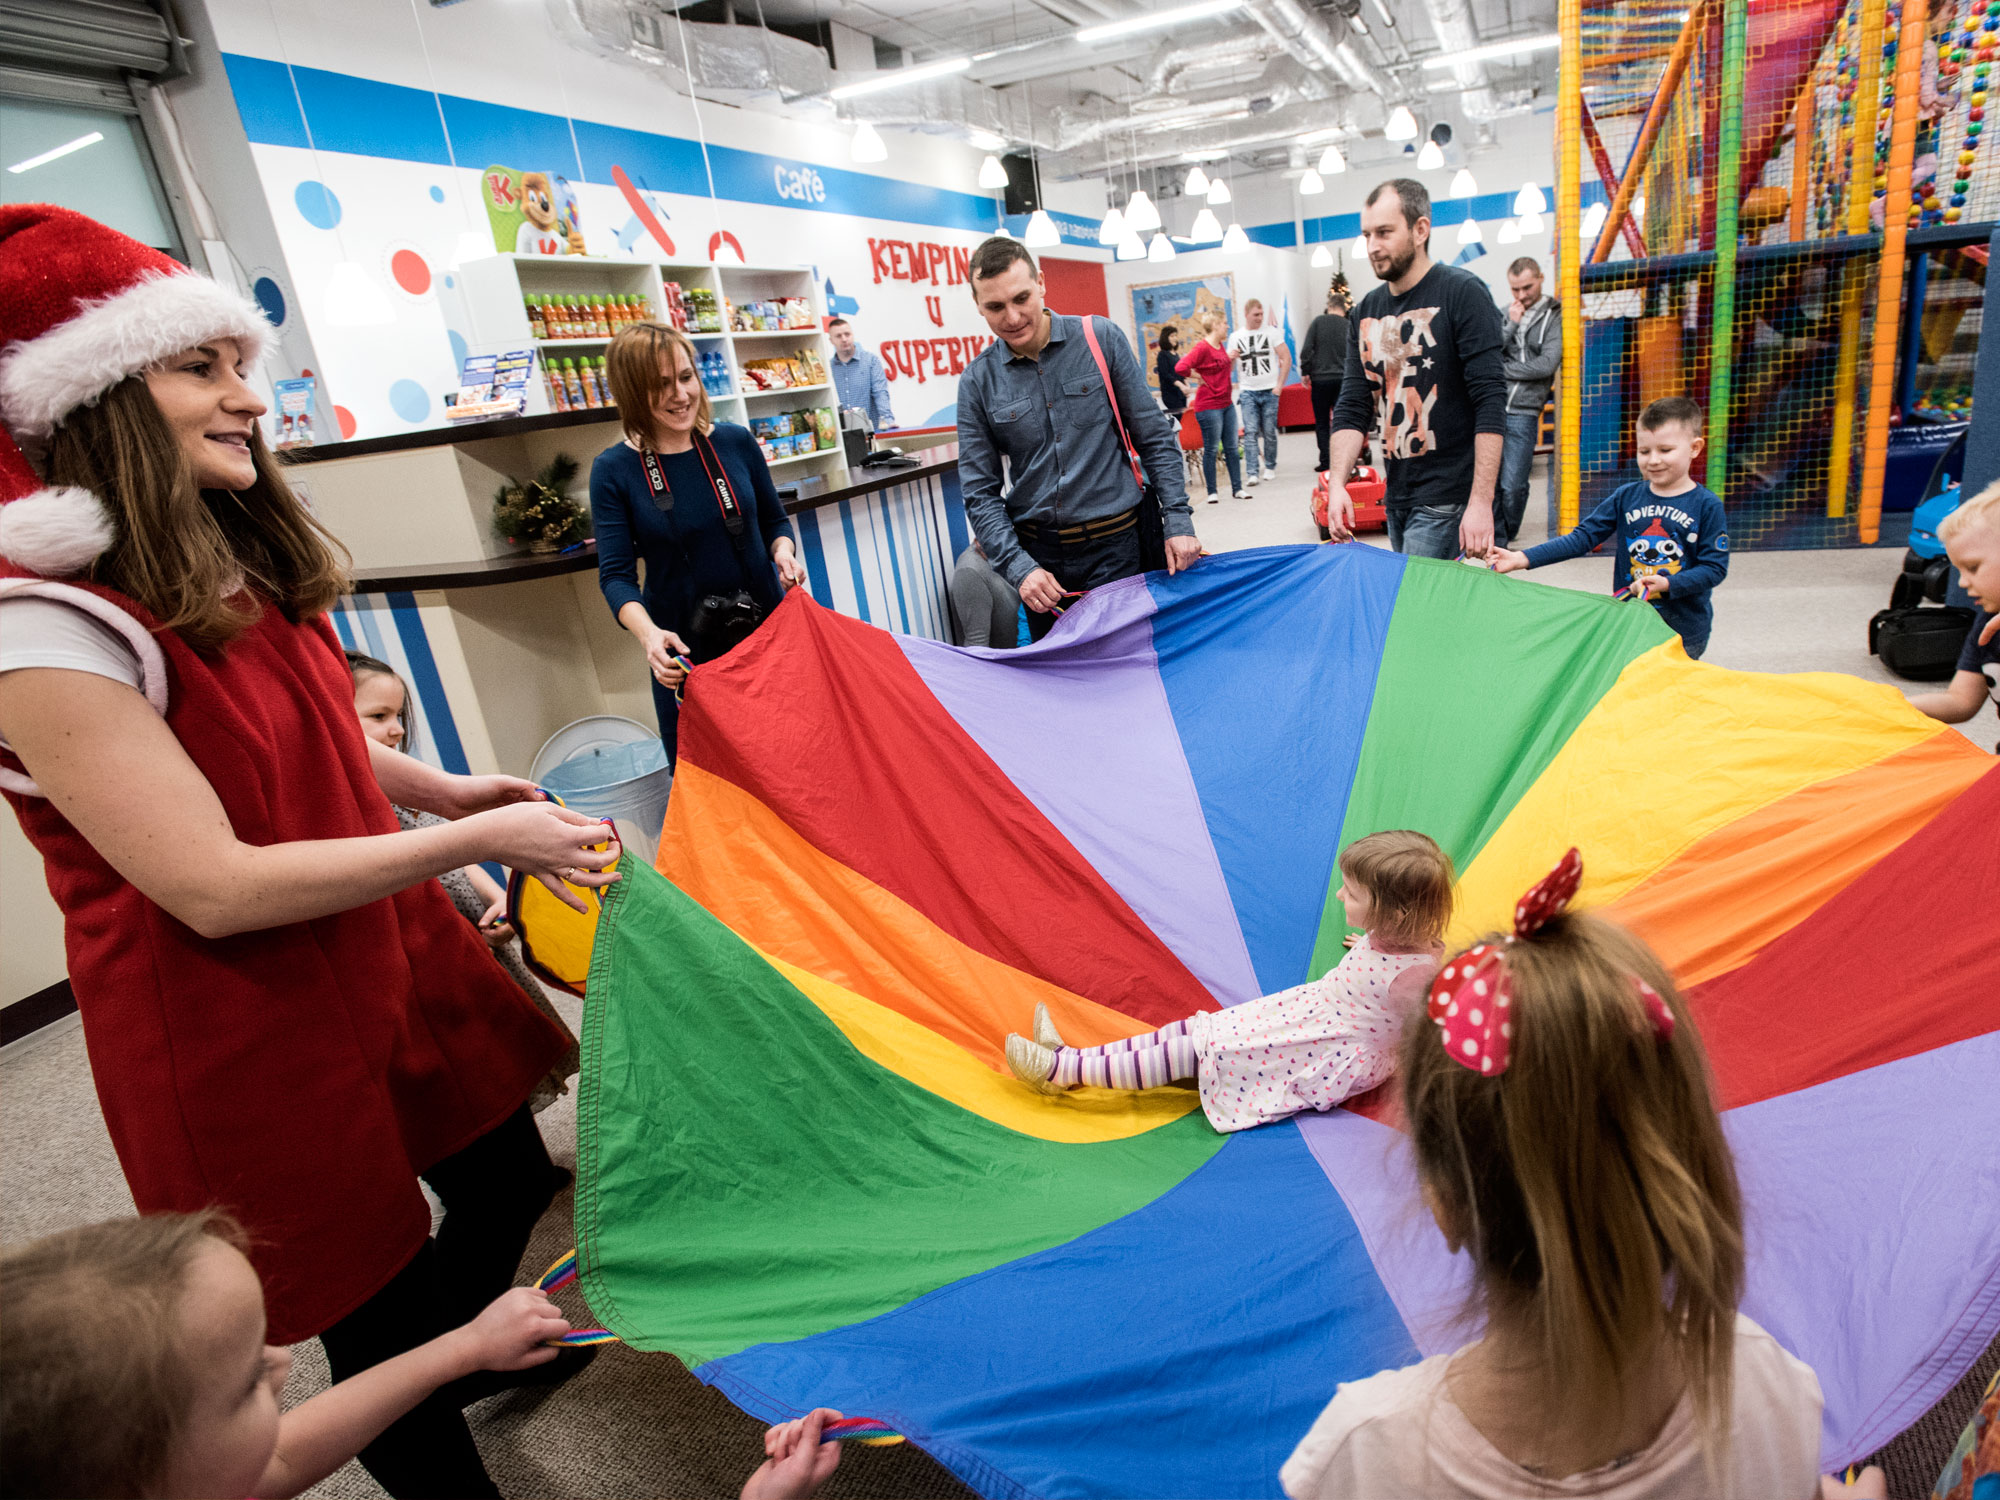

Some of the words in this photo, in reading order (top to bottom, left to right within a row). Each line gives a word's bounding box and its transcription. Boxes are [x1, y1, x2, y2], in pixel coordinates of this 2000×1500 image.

[774, 165, 826, 202] Café
[867, 237, 977, 286] KEMPIN
[925, 295, 944, 328] U
[880, 335, 994, 384] SUPERIK
[649, 468, 664, 491] EOS
[716, 478, 733, 509] Canon
[1625, 505, 1695, 529] ADVENTURE
